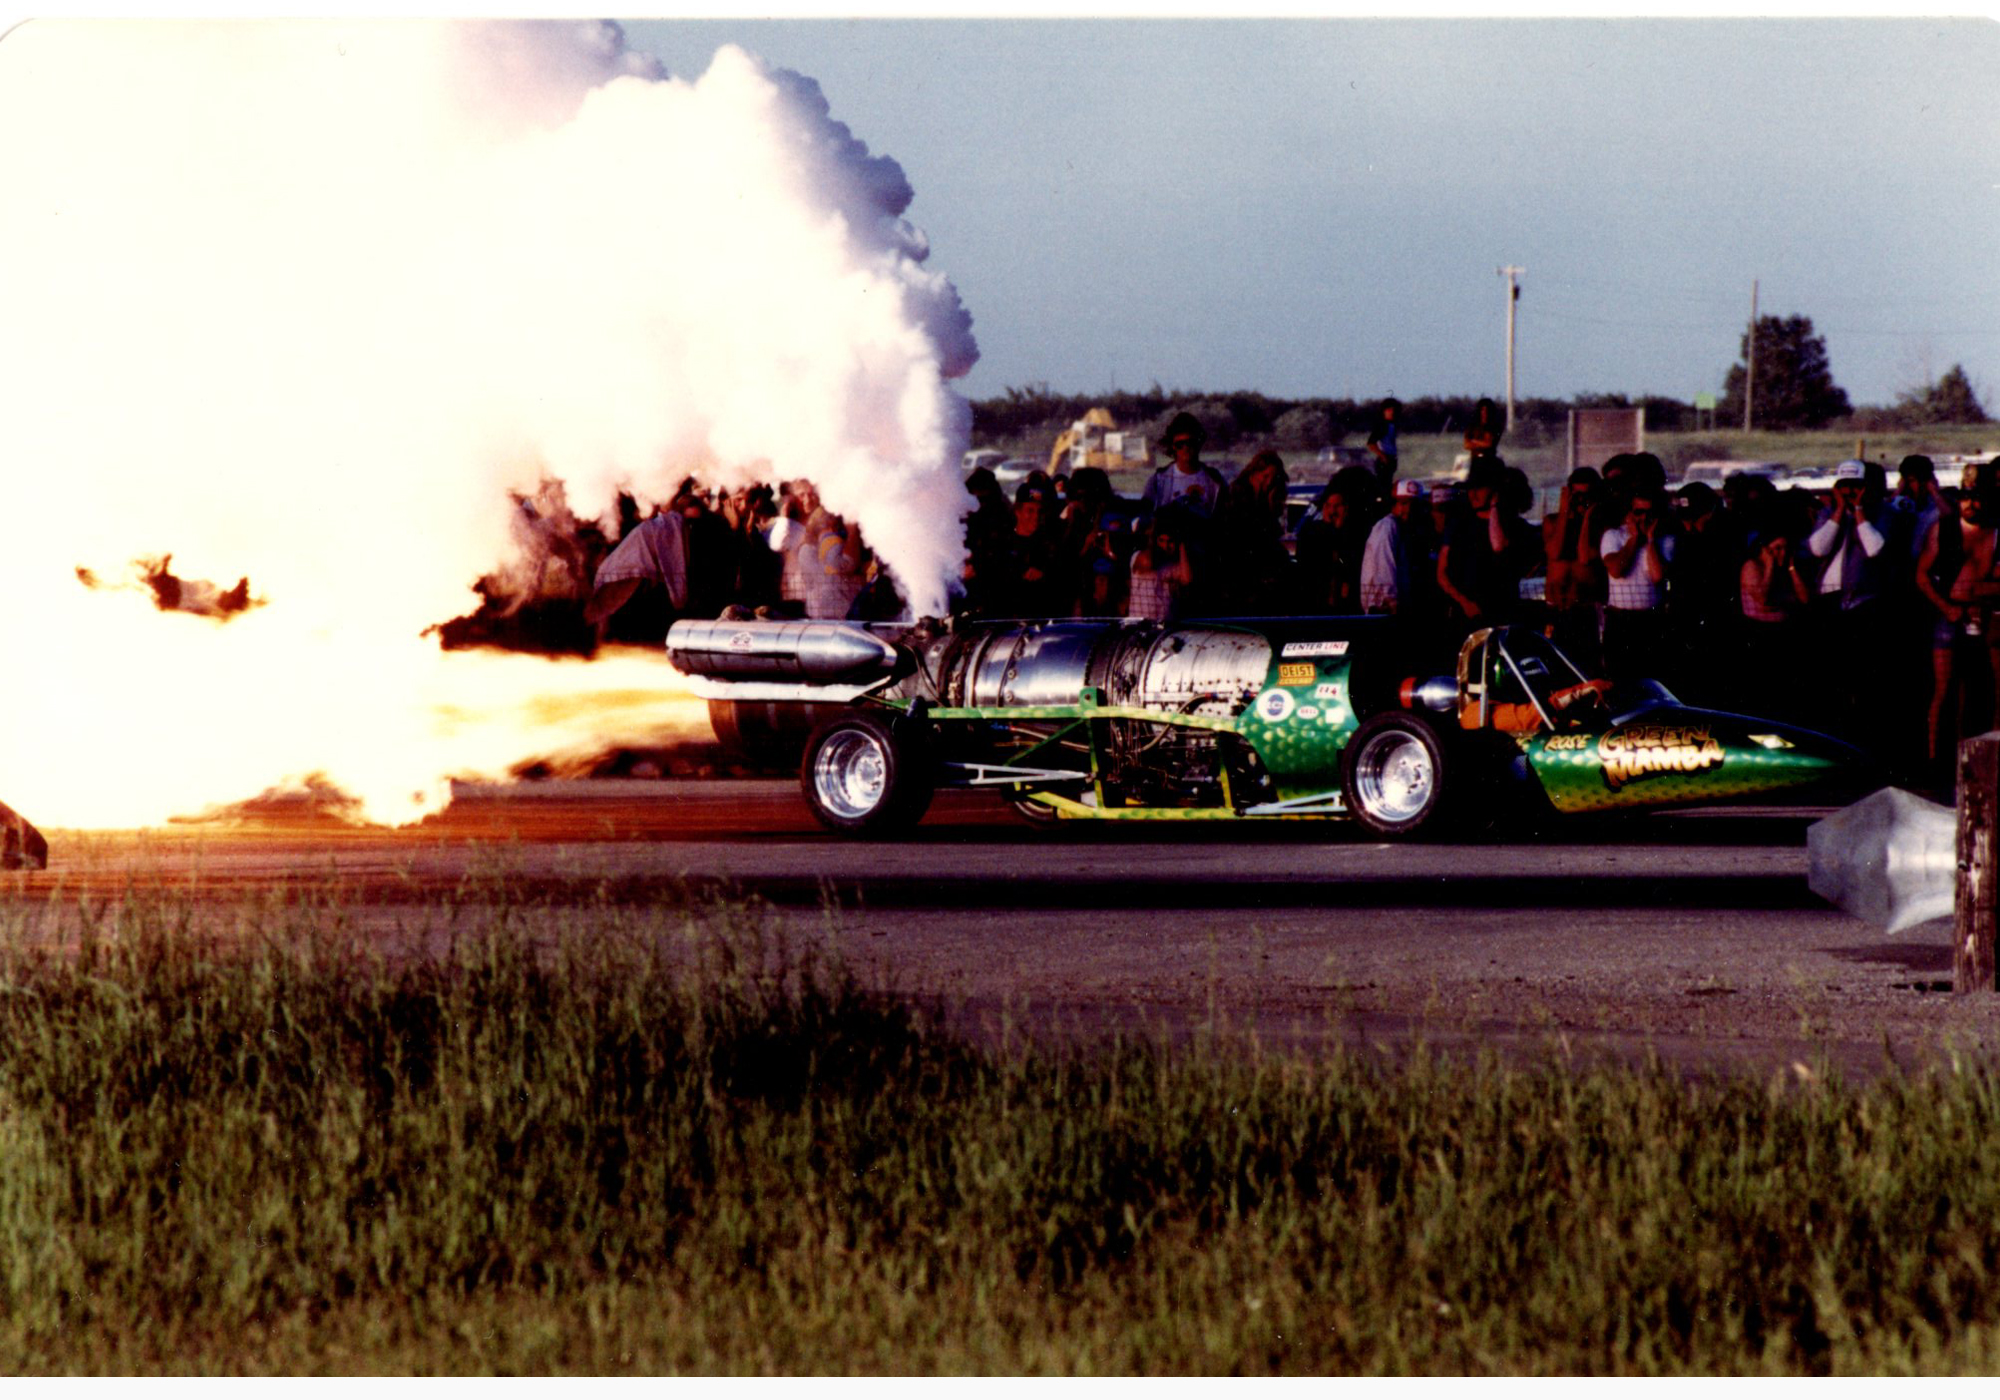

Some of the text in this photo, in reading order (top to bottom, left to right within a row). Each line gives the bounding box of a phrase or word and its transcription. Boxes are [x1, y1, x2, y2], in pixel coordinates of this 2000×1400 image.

[1285, 641, 1346, 651] CENTER LINE
[1282, 666, 1312, 676] DEIST
[1544, 733, 1592, 751] ROSE
[1598, 723, 1712, 761] GREEN
[1602, 738, 1726, 789] MAMBA
